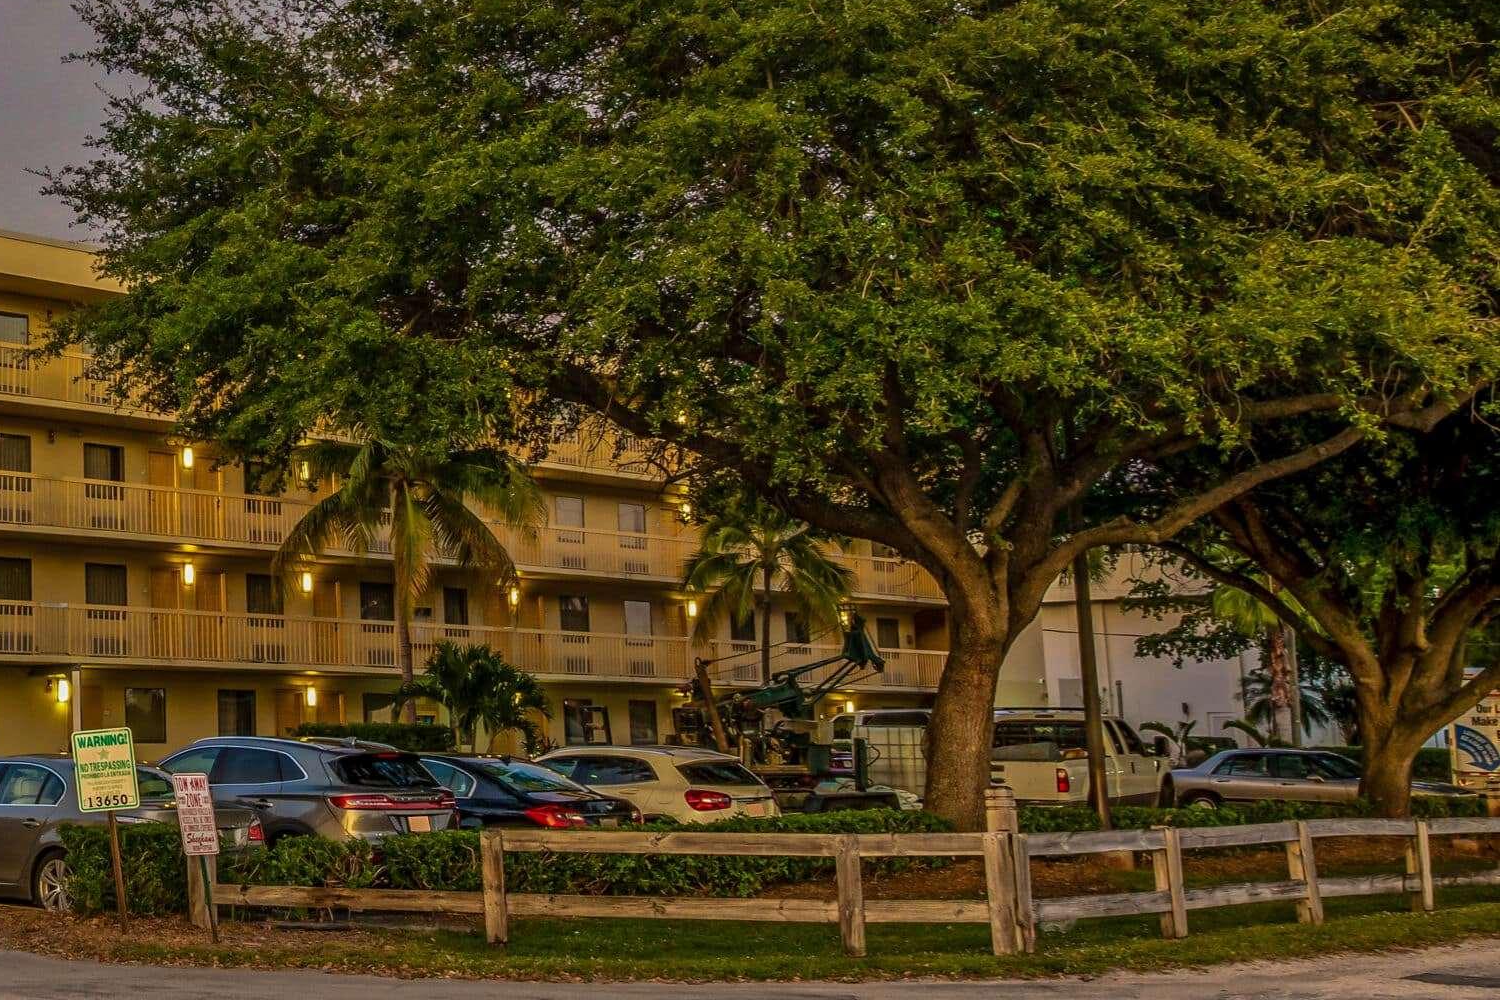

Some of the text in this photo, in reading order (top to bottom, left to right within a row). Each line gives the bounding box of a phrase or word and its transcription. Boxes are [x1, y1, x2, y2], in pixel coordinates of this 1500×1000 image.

[1471, 716, 1499, 727] Make
[77, 733, 128, 749] WARNING!
[80, 760, 131, 773] NO TRESPASSING
[175, 777, 207, 792] TOW AWAY
[88, 794, 128, 808] 13650
[185, 793, 203, 808] ZONE
